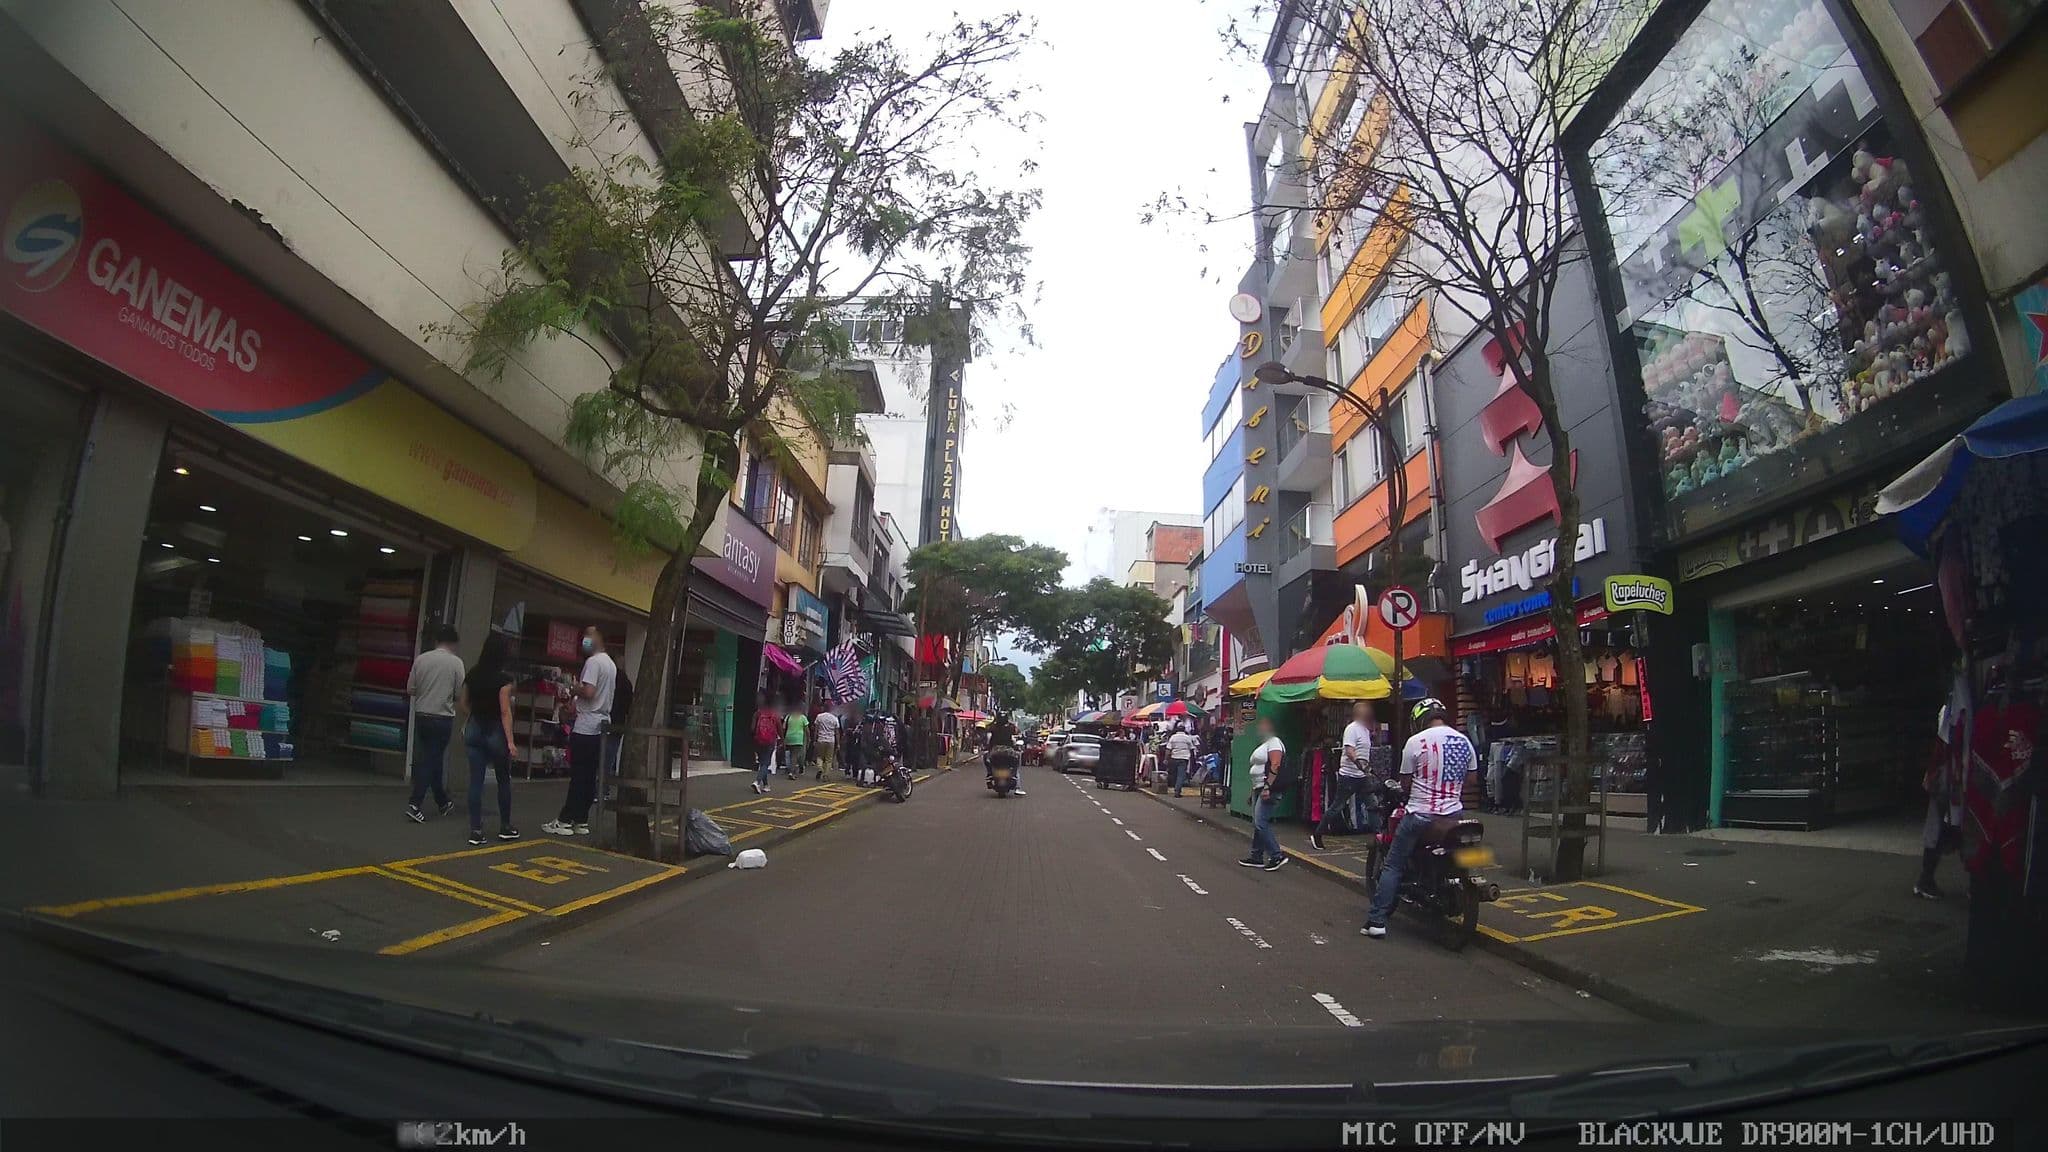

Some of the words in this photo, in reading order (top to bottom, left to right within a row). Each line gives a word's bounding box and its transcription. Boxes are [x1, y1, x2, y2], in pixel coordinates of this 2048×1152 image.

[88, 238, 261, 373] GANEMAS
[118, 307, 177, 351] GANAMOS
[178, 341, 216, 372] TODOS
[946, 387, 958, 434] LUNA
[942, 439, 955, 500] PLAZA
[1235, 562, 1272, 574] HOTEL
[1391, 592, 1412, 625] P
[1611, 581, 1666, 604] Rapeluches
